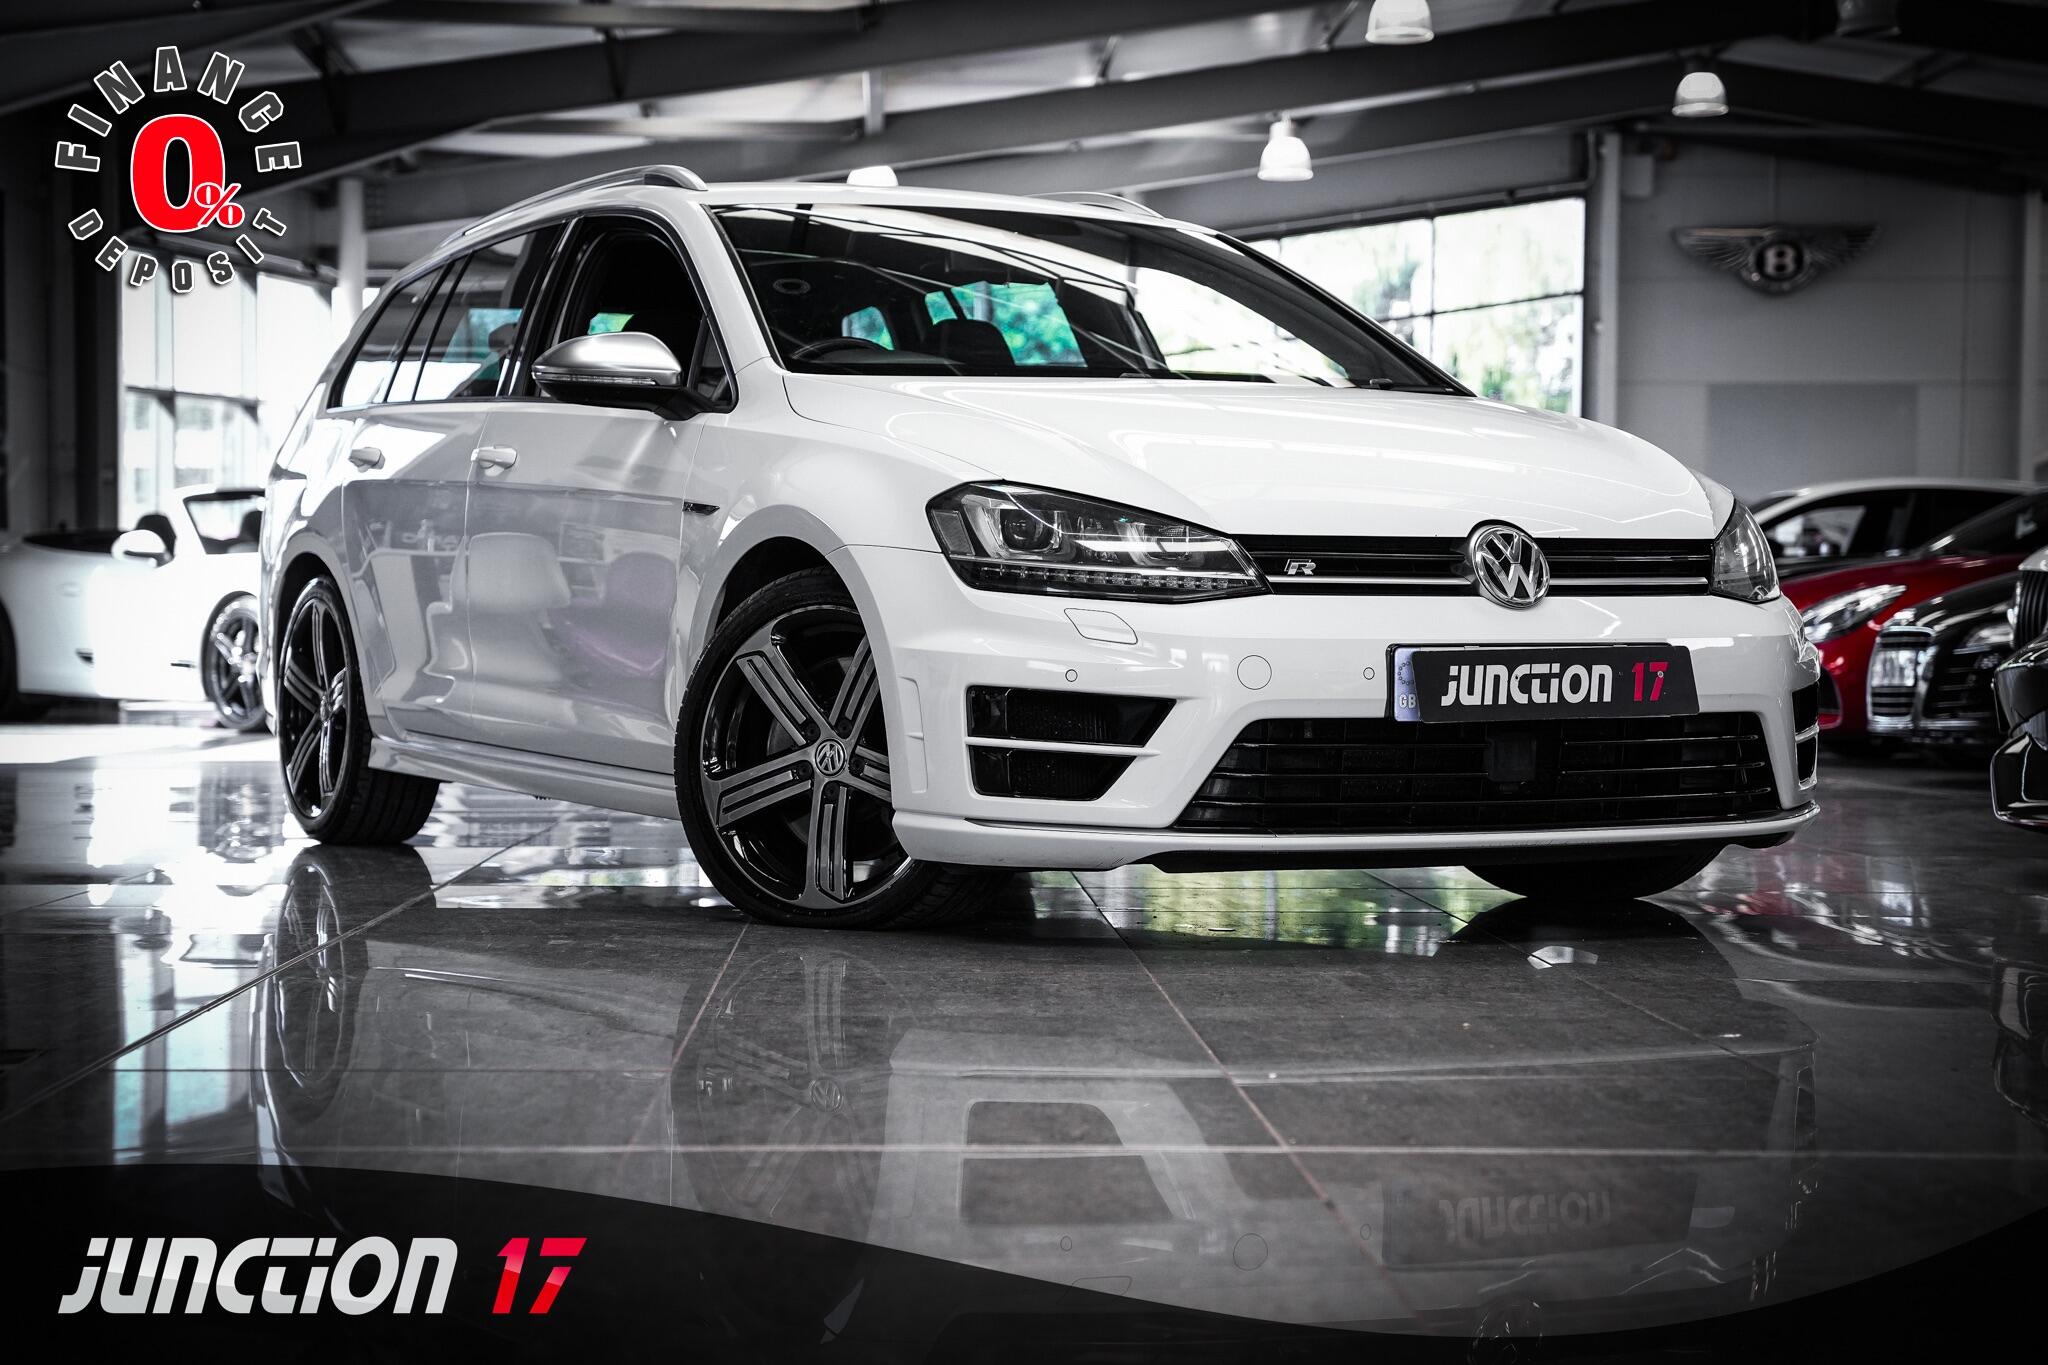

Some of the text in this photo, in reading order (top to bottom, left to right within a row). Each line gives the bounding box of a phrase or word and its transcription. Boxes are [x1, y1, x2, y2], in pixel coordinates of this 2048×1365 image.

[1764, 247, 1797, 276] B
[1284, 558, 1317, 576] R
[1632, 661, 1669, 702] 17
[1399, 693, 1417, 709] GB
